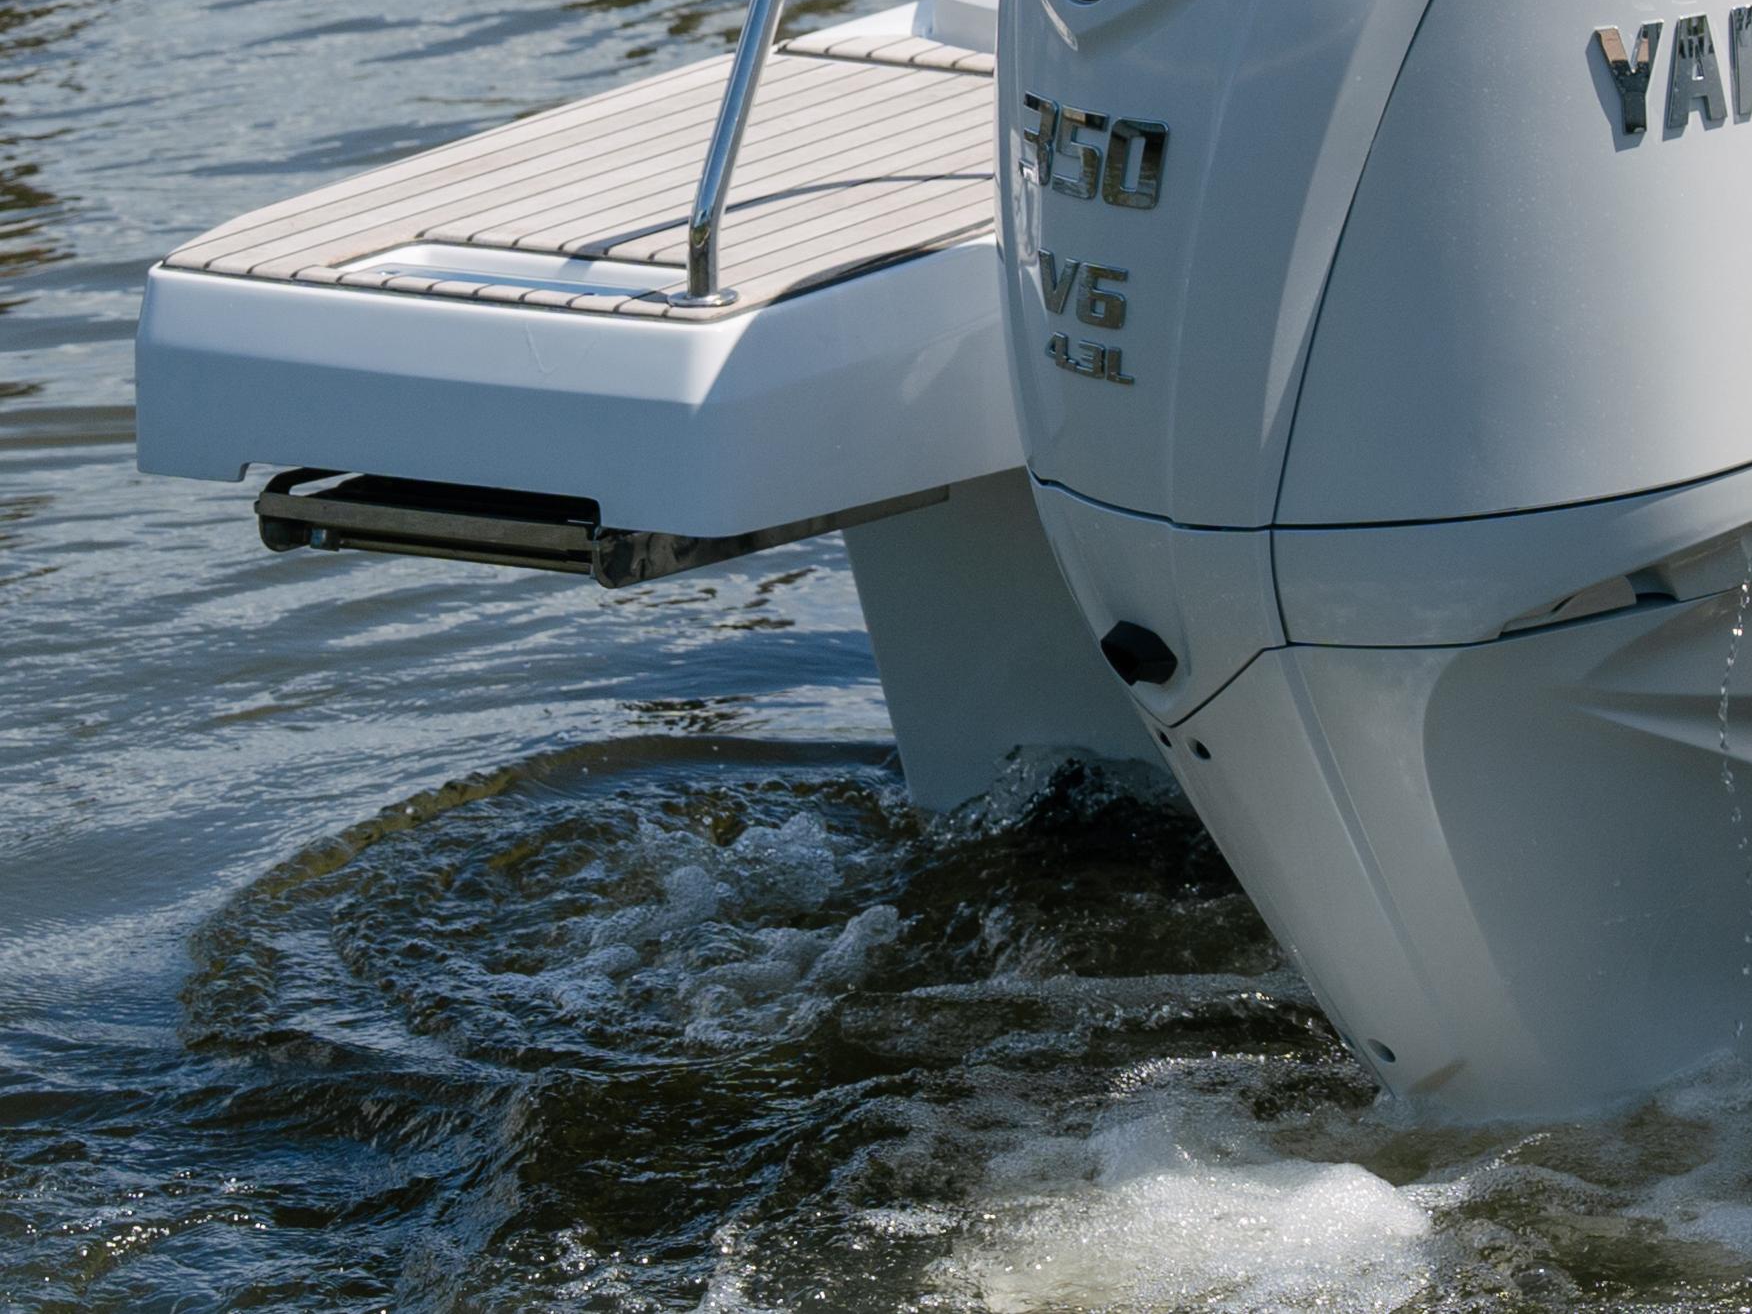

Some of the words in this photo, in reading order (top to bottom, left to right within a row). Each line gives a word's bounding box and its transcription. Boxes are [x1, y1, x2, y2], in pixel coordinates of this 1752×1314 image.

[1018, 90, 1169, 210] 350
[1038, 248, 1129, 330] V6
[1046, 332, 1135, 385] 4.3L
